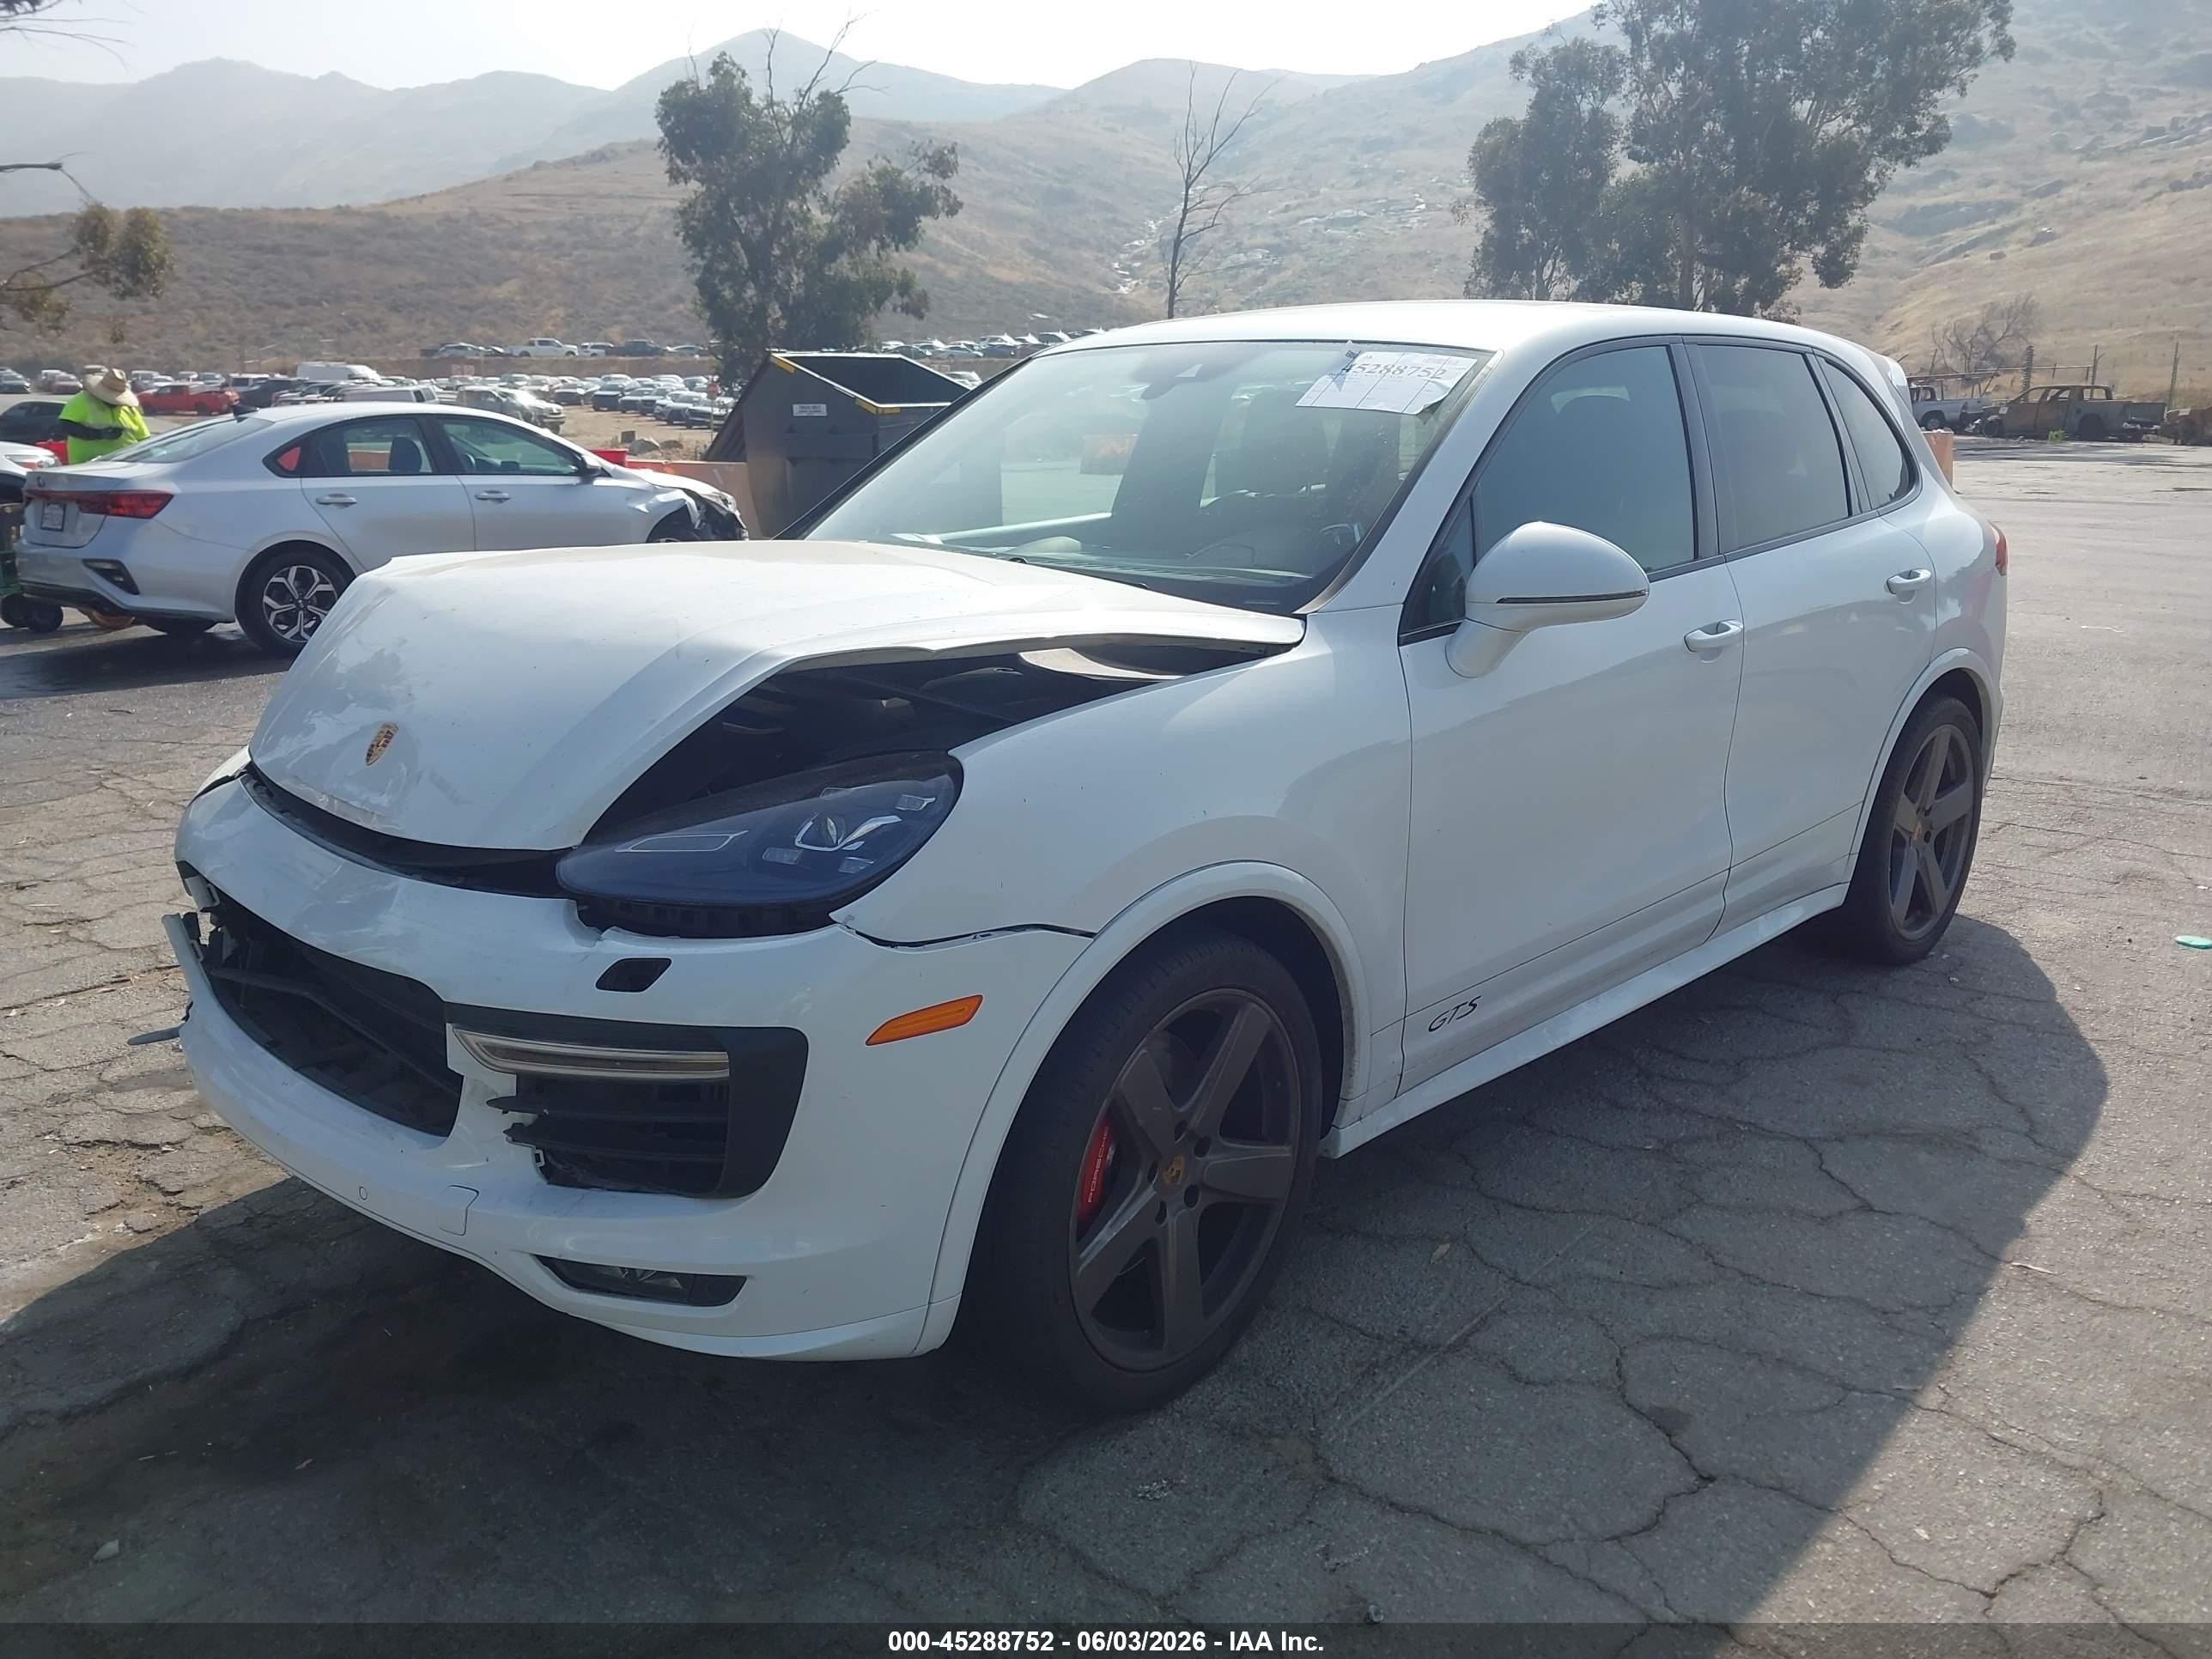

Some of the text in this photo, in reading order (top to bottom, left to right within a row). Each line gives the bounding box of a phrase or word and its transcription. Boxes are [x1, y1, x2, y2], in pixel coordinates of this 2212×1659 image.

[1341, 363, 1447, 379] 45288752
[1428, 994, 1482, 1032] GTS
[1087, 1126, 1109, 1203] PORSCHE
